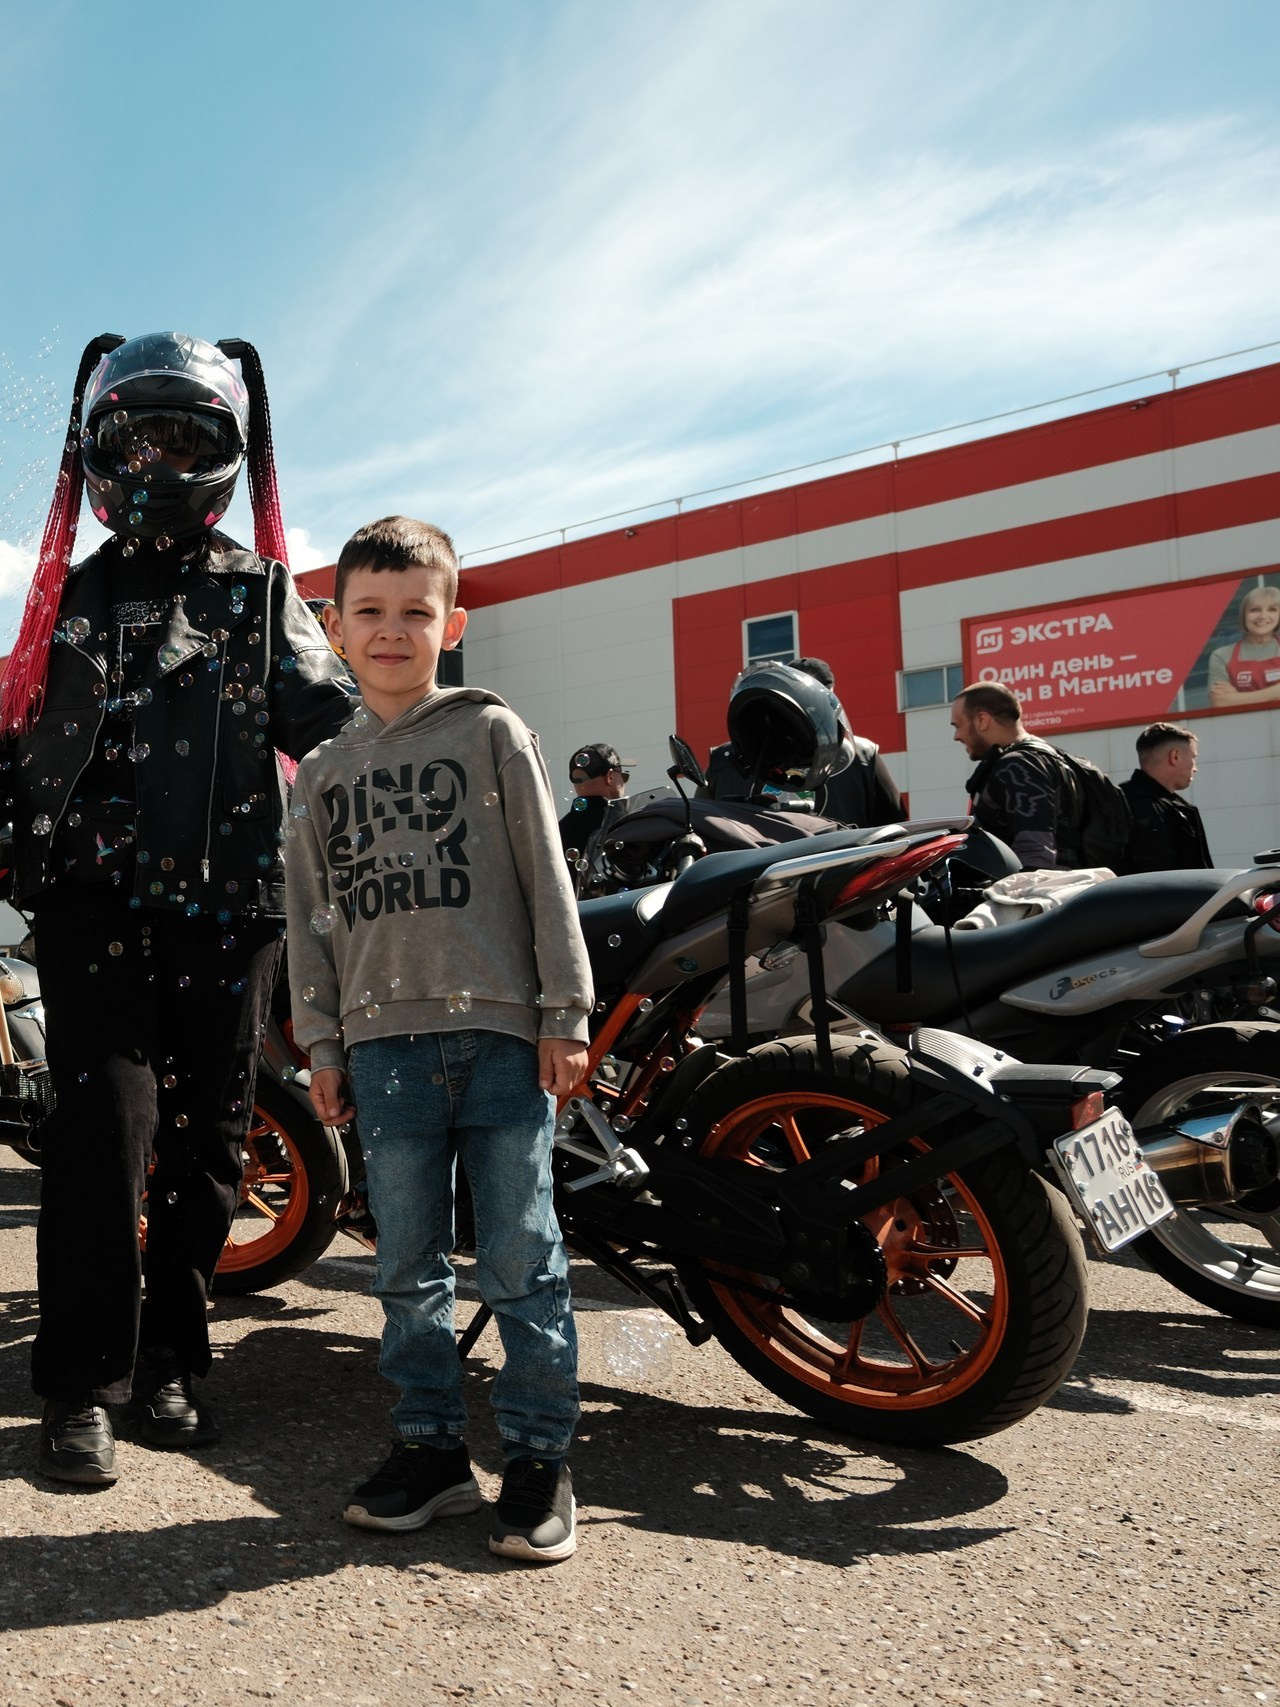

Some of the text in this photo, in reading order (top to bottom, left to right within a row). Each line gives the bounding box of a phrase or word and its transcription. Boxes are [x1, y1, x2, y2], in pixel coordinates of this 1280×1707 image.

[1010, 613, 1113, 645] ЭКСТРА
[979, 663, 1044, 684] Один
[1050, 654, 1114, 678] день
[1014, 668, 1173, 702] ы в Магните
[321, 759, 467, 839] DINO
[337, 868, 470, 933] WORLD
[1073, 1121, 1131, 1177] 1716
[1118, 1163, 1135, 1178] RUS
[1135, 1173, 1165, 1216] 16
